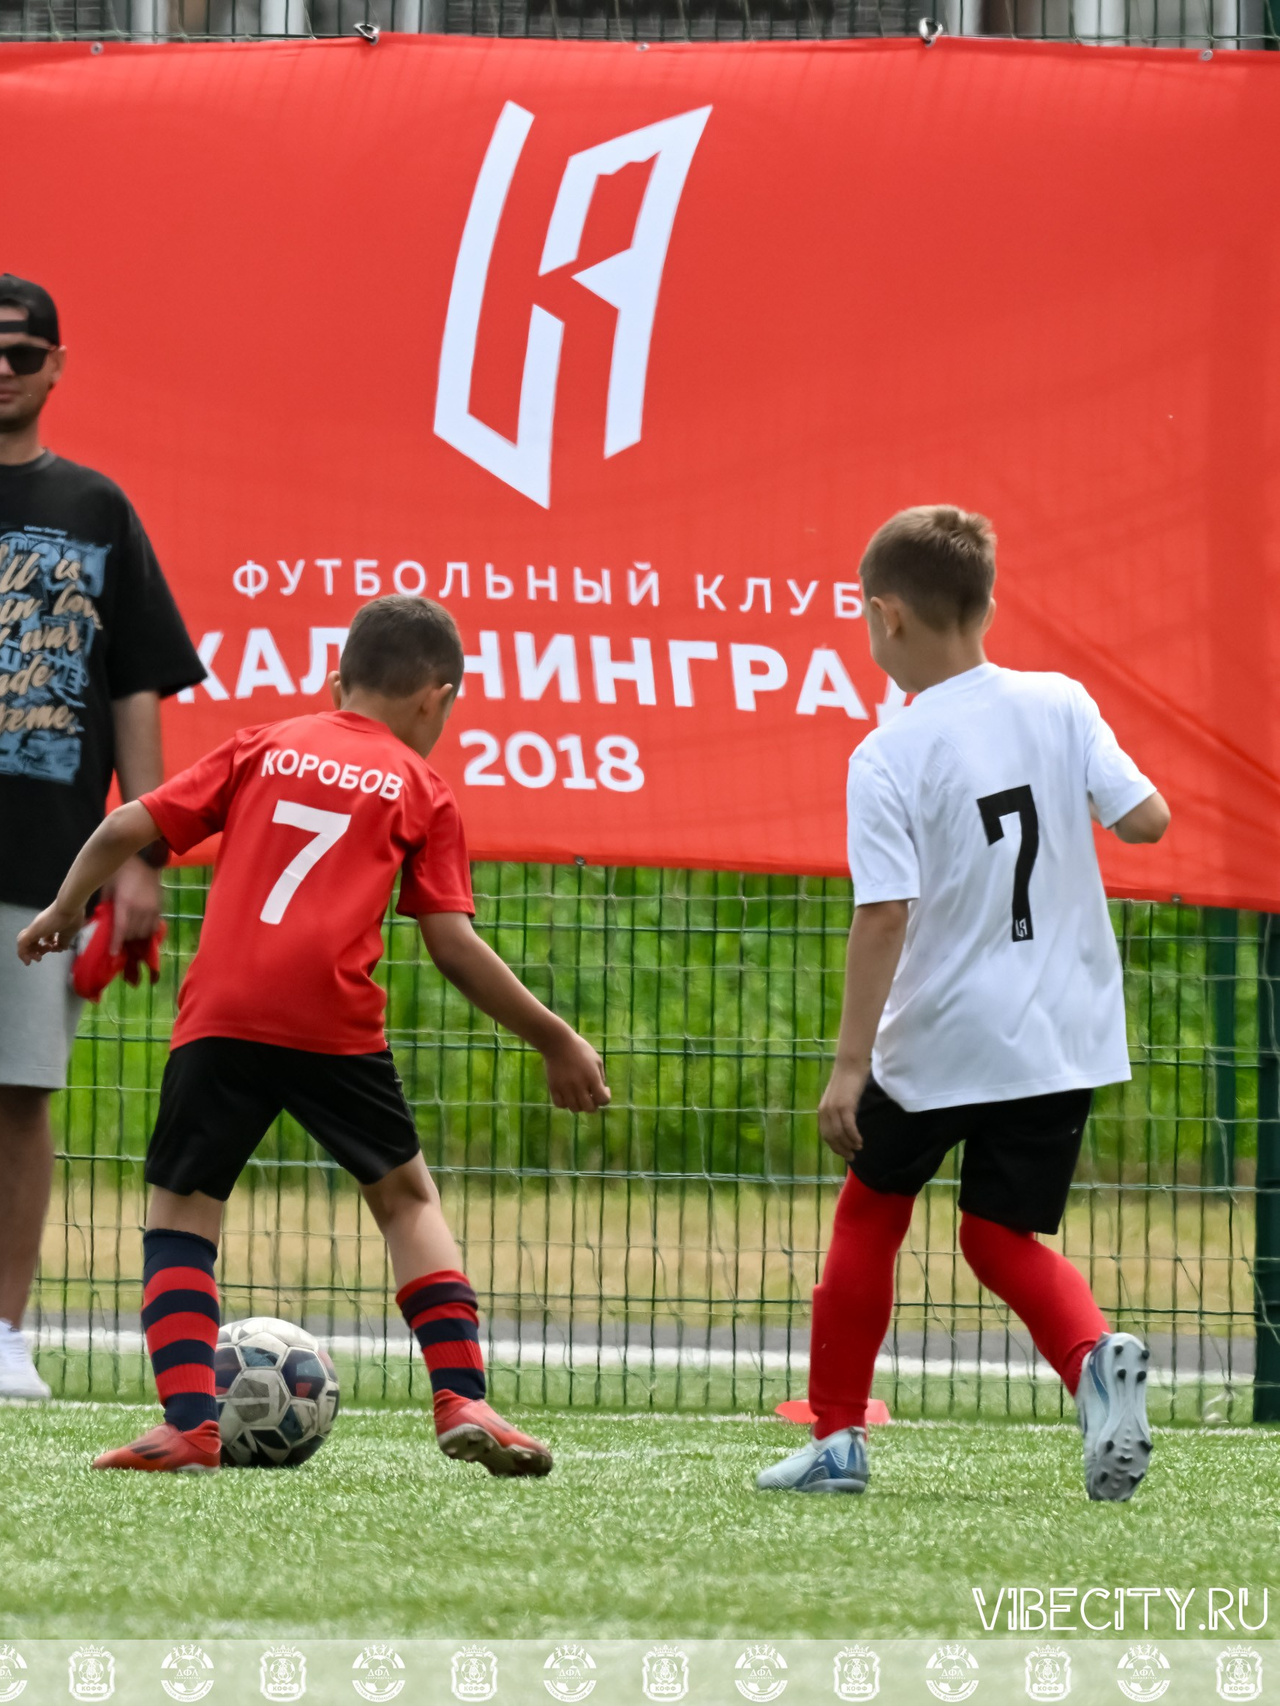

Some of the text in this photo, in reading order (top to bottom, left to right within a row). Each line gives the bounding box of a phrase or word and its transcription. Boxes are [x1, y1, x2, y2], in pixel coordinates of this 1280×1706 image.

[232, 558, 863, 620] ФУТБОЛЬНЫЙ КЛУБ
[260, 747, 404, 801] КОРОБОВ
[459, 729, 645, 793] 2018
[259, 799, 352, 925] 7
[976, 784, 1039, 942] 7
